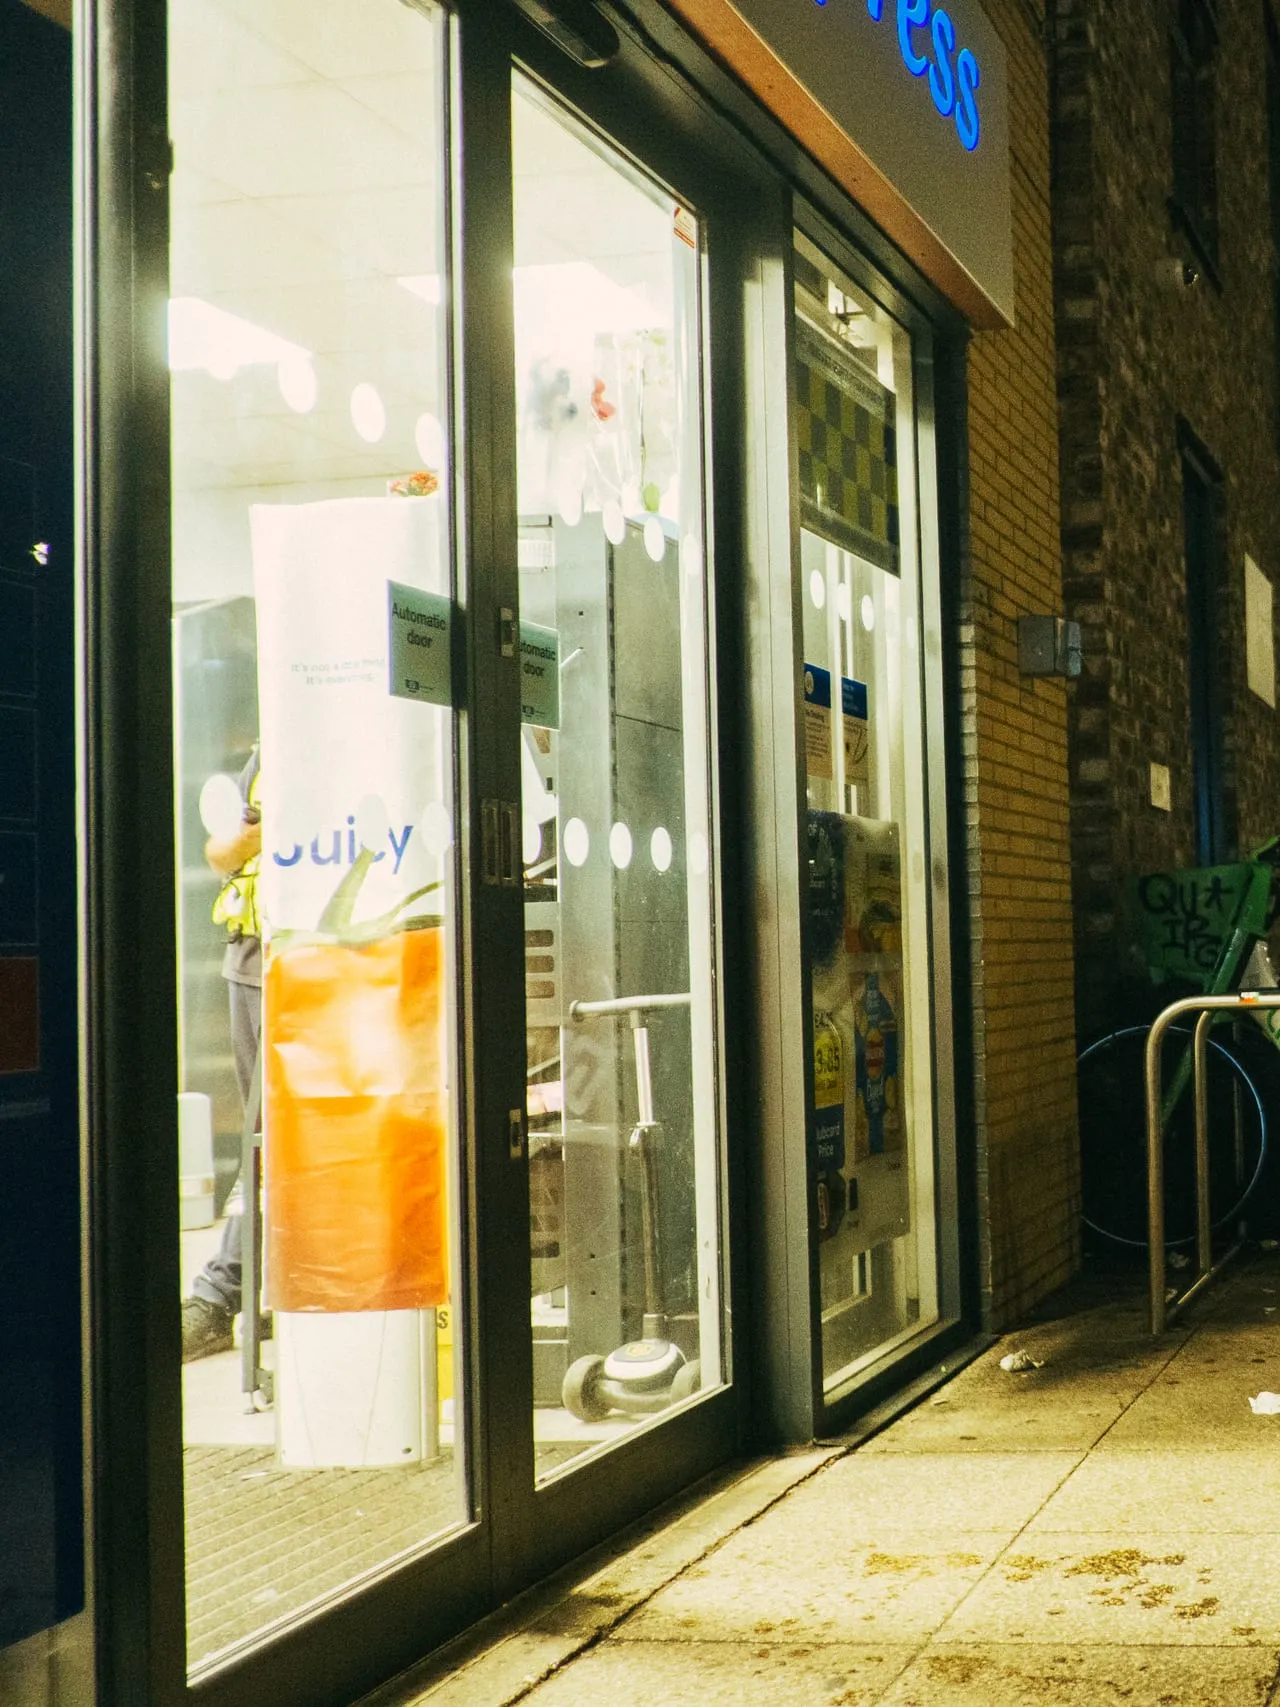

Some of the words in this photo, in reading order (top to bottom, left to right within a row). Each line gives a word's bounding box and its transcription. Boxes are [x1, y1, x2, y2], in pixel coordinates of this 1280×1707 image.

[392, 602, 447, 631] Automatic
[406, 629, 433, 648] door
[522, 661, 545, 677] door
